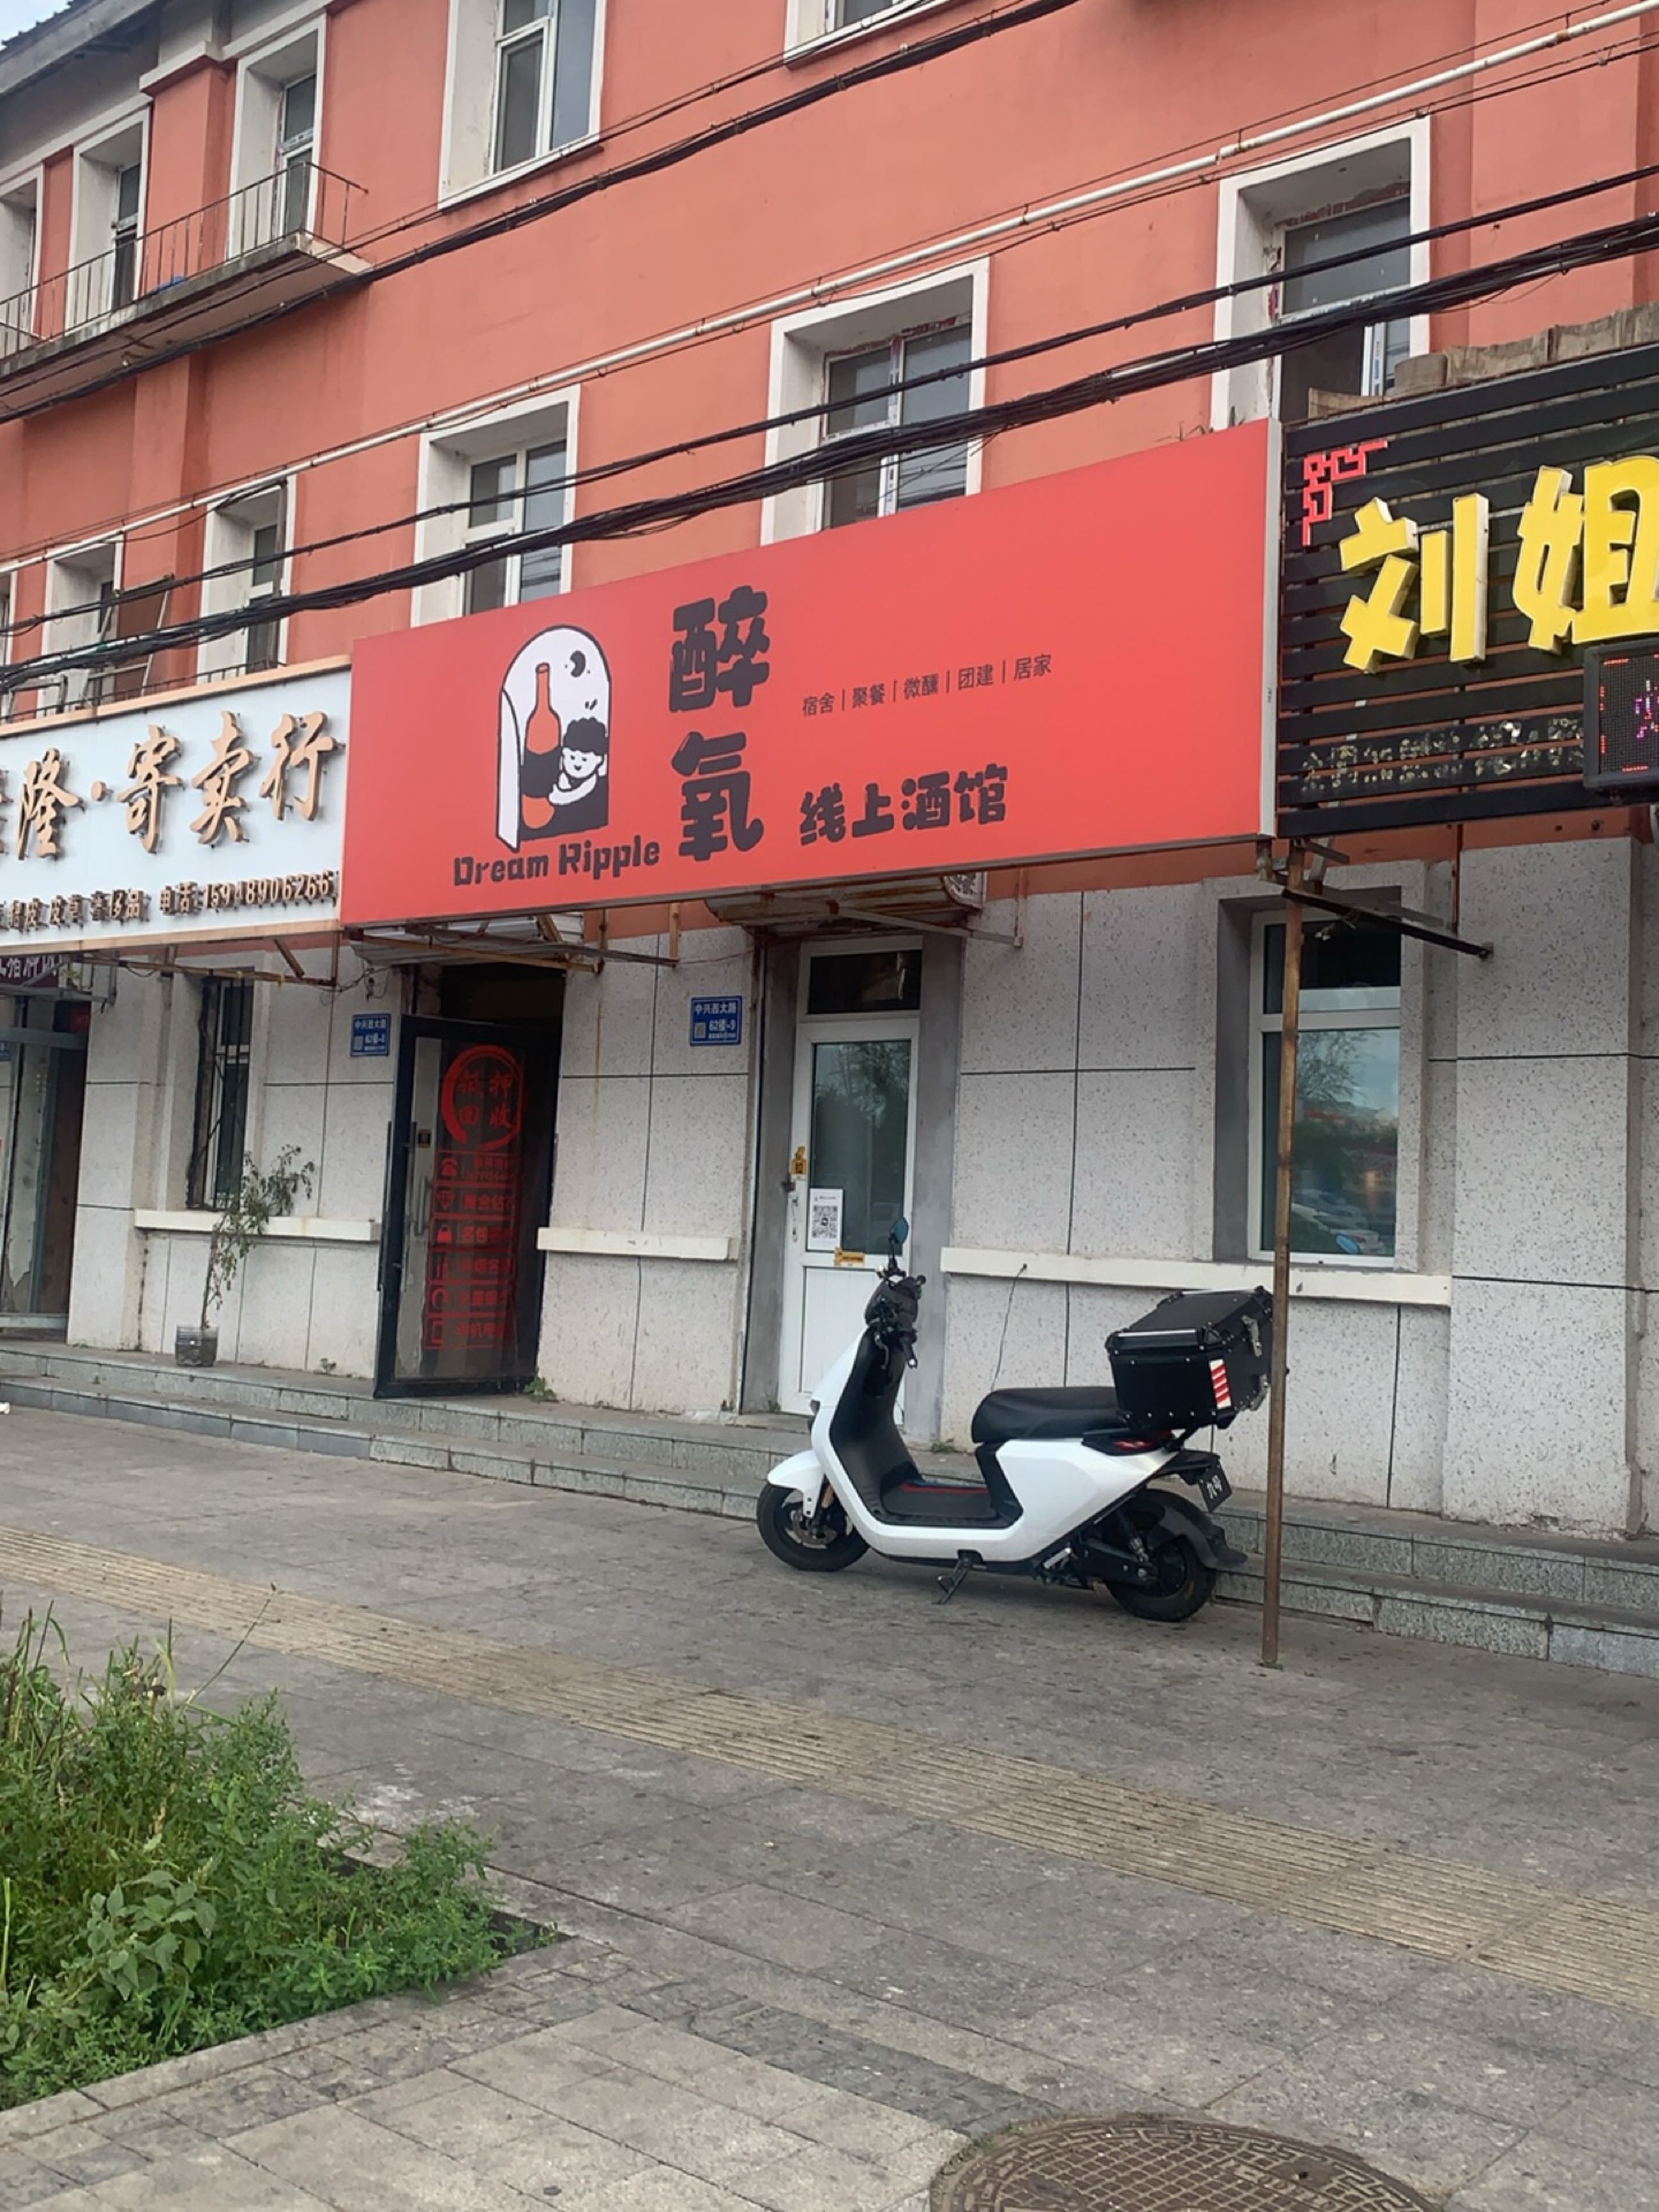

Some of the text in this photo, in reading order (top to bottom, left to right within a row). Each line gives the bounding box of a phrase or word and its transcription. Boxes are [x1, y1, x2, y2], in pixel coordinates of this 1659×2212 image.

[669, 585, 770, 862] 醉氧
[802, 692, 835, 716] 宿舍
[852, 683, 885, 709] 聚餐
[958, 664, 994, 690] 团建
[1013, 653, 1052, 680] 居家
[0, 712, 337, 860] 隆·寄卖行
[800, 764, 1008, 846] 线上酒馆
[454, 836, 660, 886] Dream Ripple
